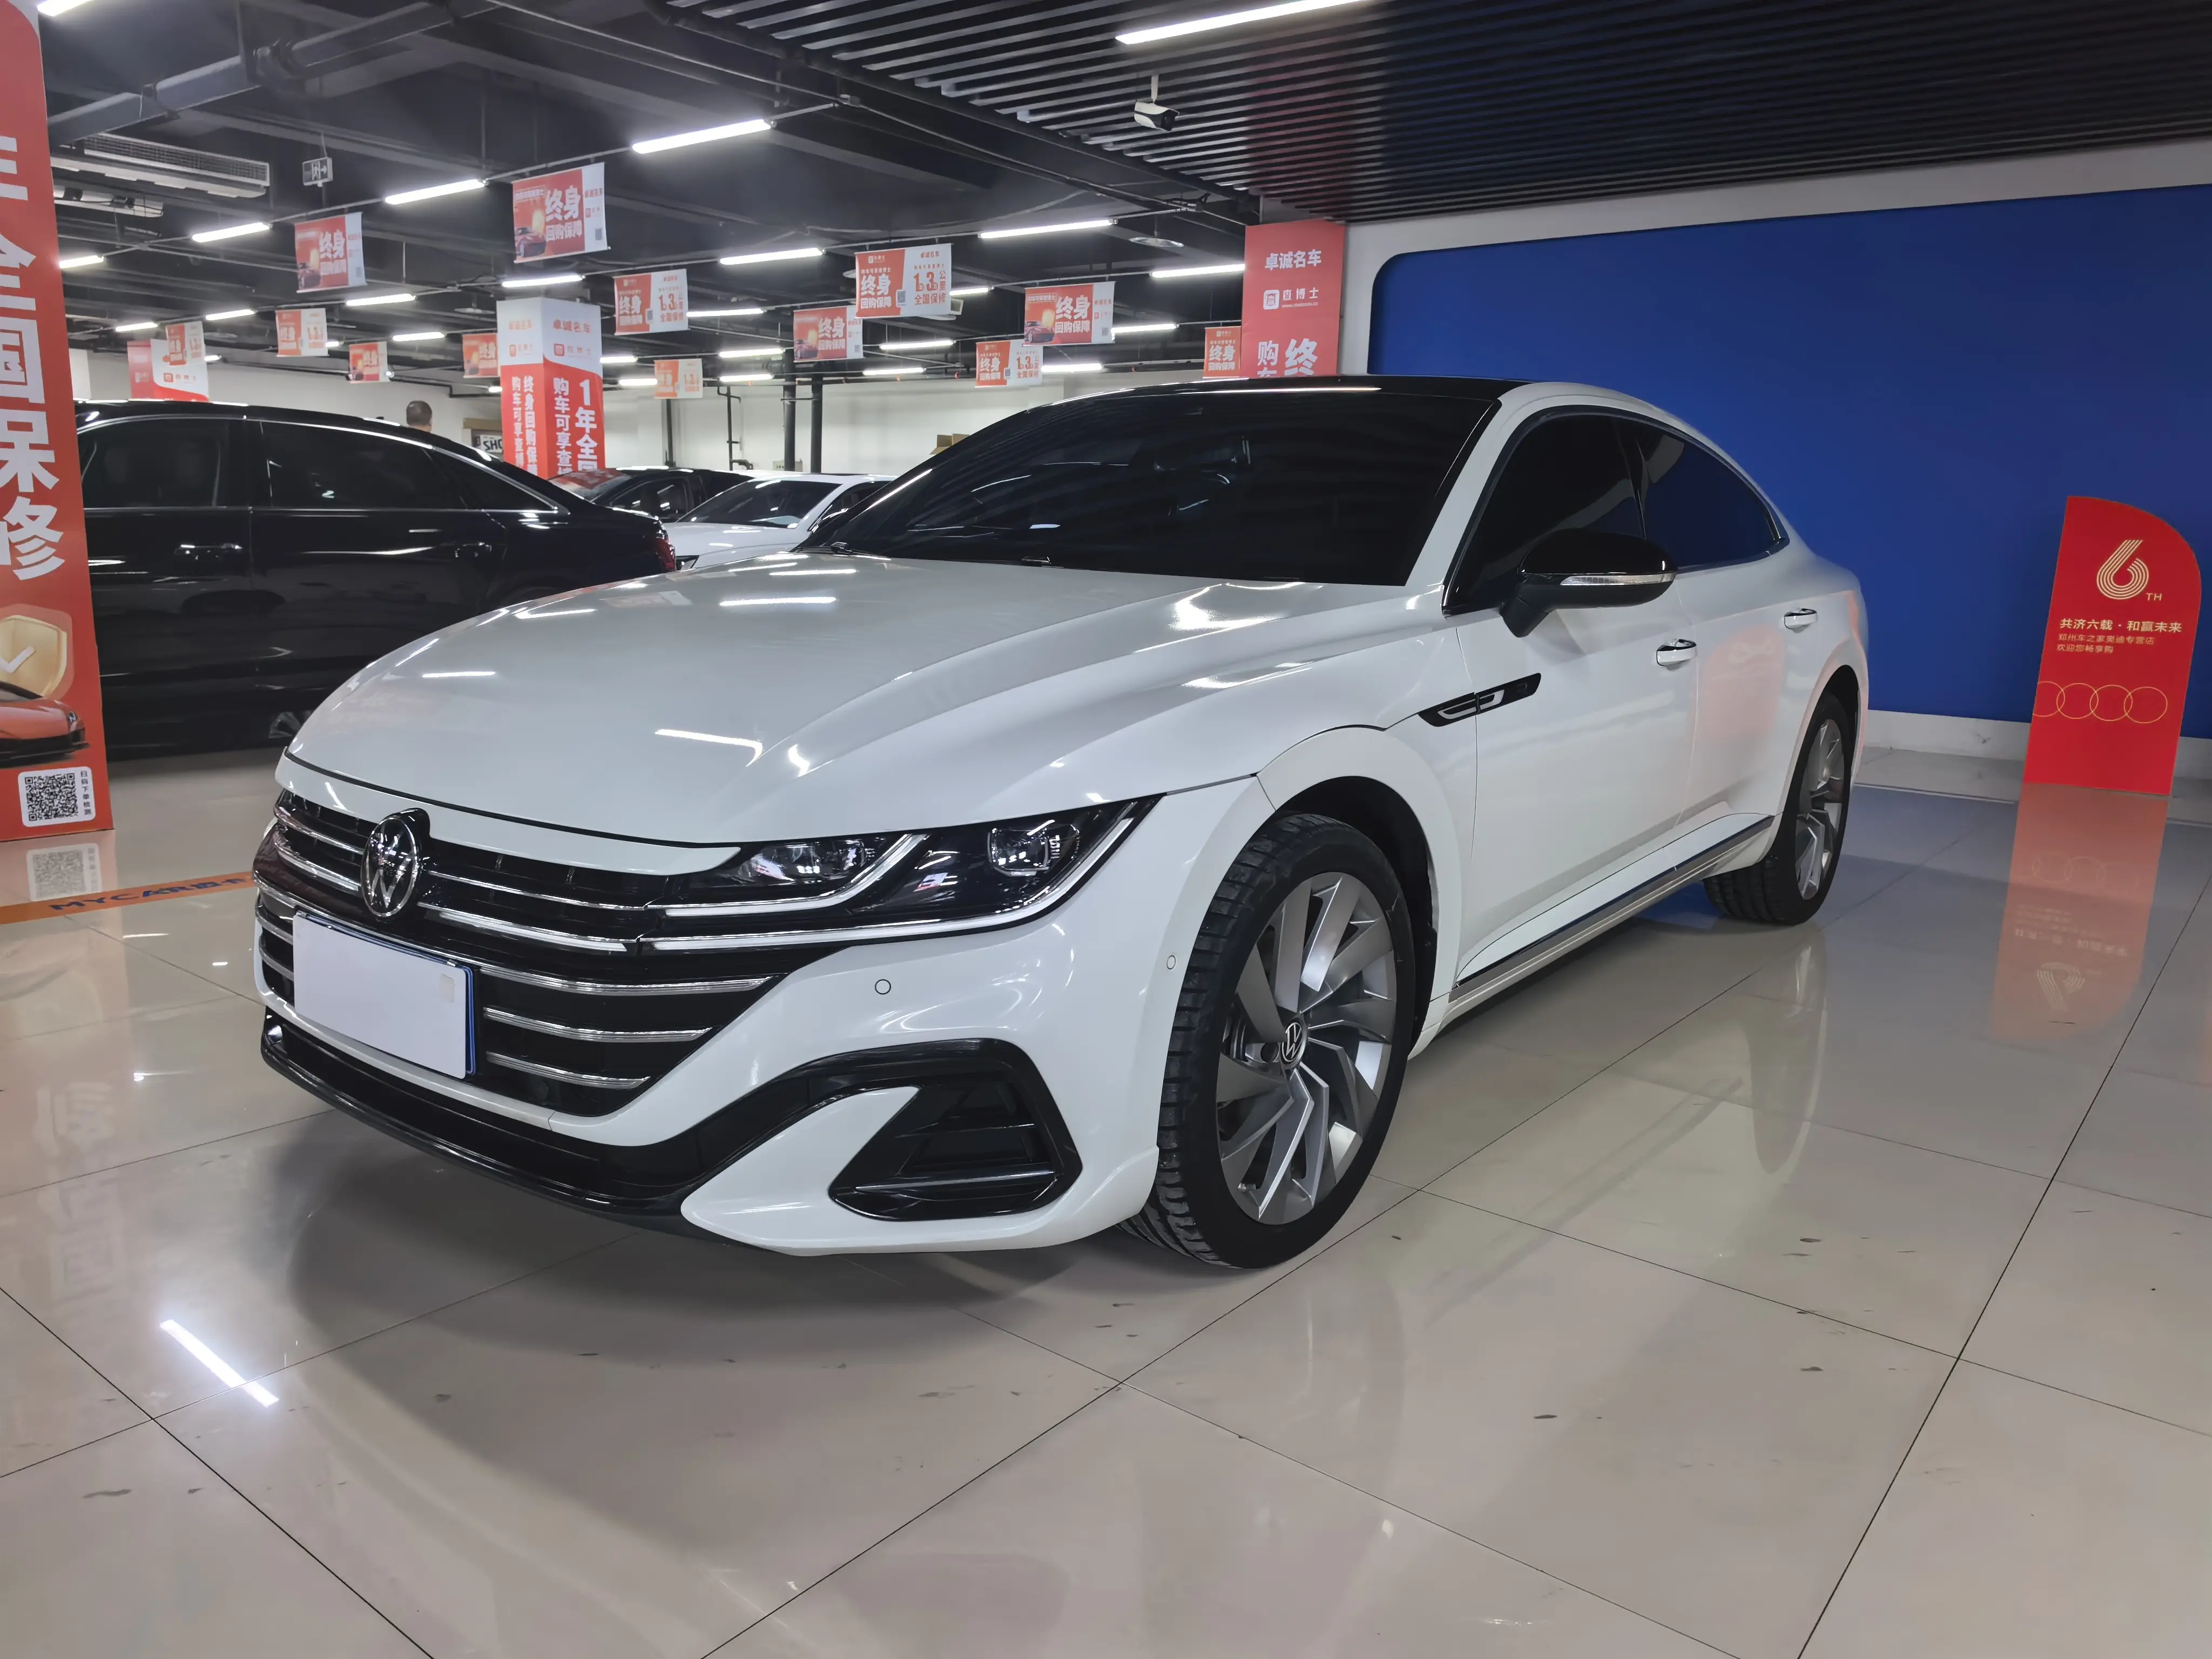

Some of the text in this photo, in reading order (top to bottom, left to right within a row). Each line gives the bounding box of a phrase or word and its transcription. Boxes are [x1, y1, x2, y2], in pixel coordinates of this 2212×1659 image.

[545, 185, 581, 222] 终身
[319, 229, 346, 259] 终身
[1265, 249, 1322, 270] 卓诚名车
[861, 273, 891, 296] 终身
[1282, 287, 1319, 301] 查博士
[619, 295, 642, 314] 终身
[860, 296, 892, 309] 回购保障
[1056, 295, 1091, 320] 终身
[818, 316, 845, 338] 终身
[1055, 320, 1091, 334] 回购保障
[1209, 344, 1236, 361] 终身
[1284, 338, 1318, 376] 终
[980, 356, 1000, 372] 终身
[2146, 592, 2163, 602] TH
[2058, 633, 2155, 645] 郑州车之家奥迪专营店
